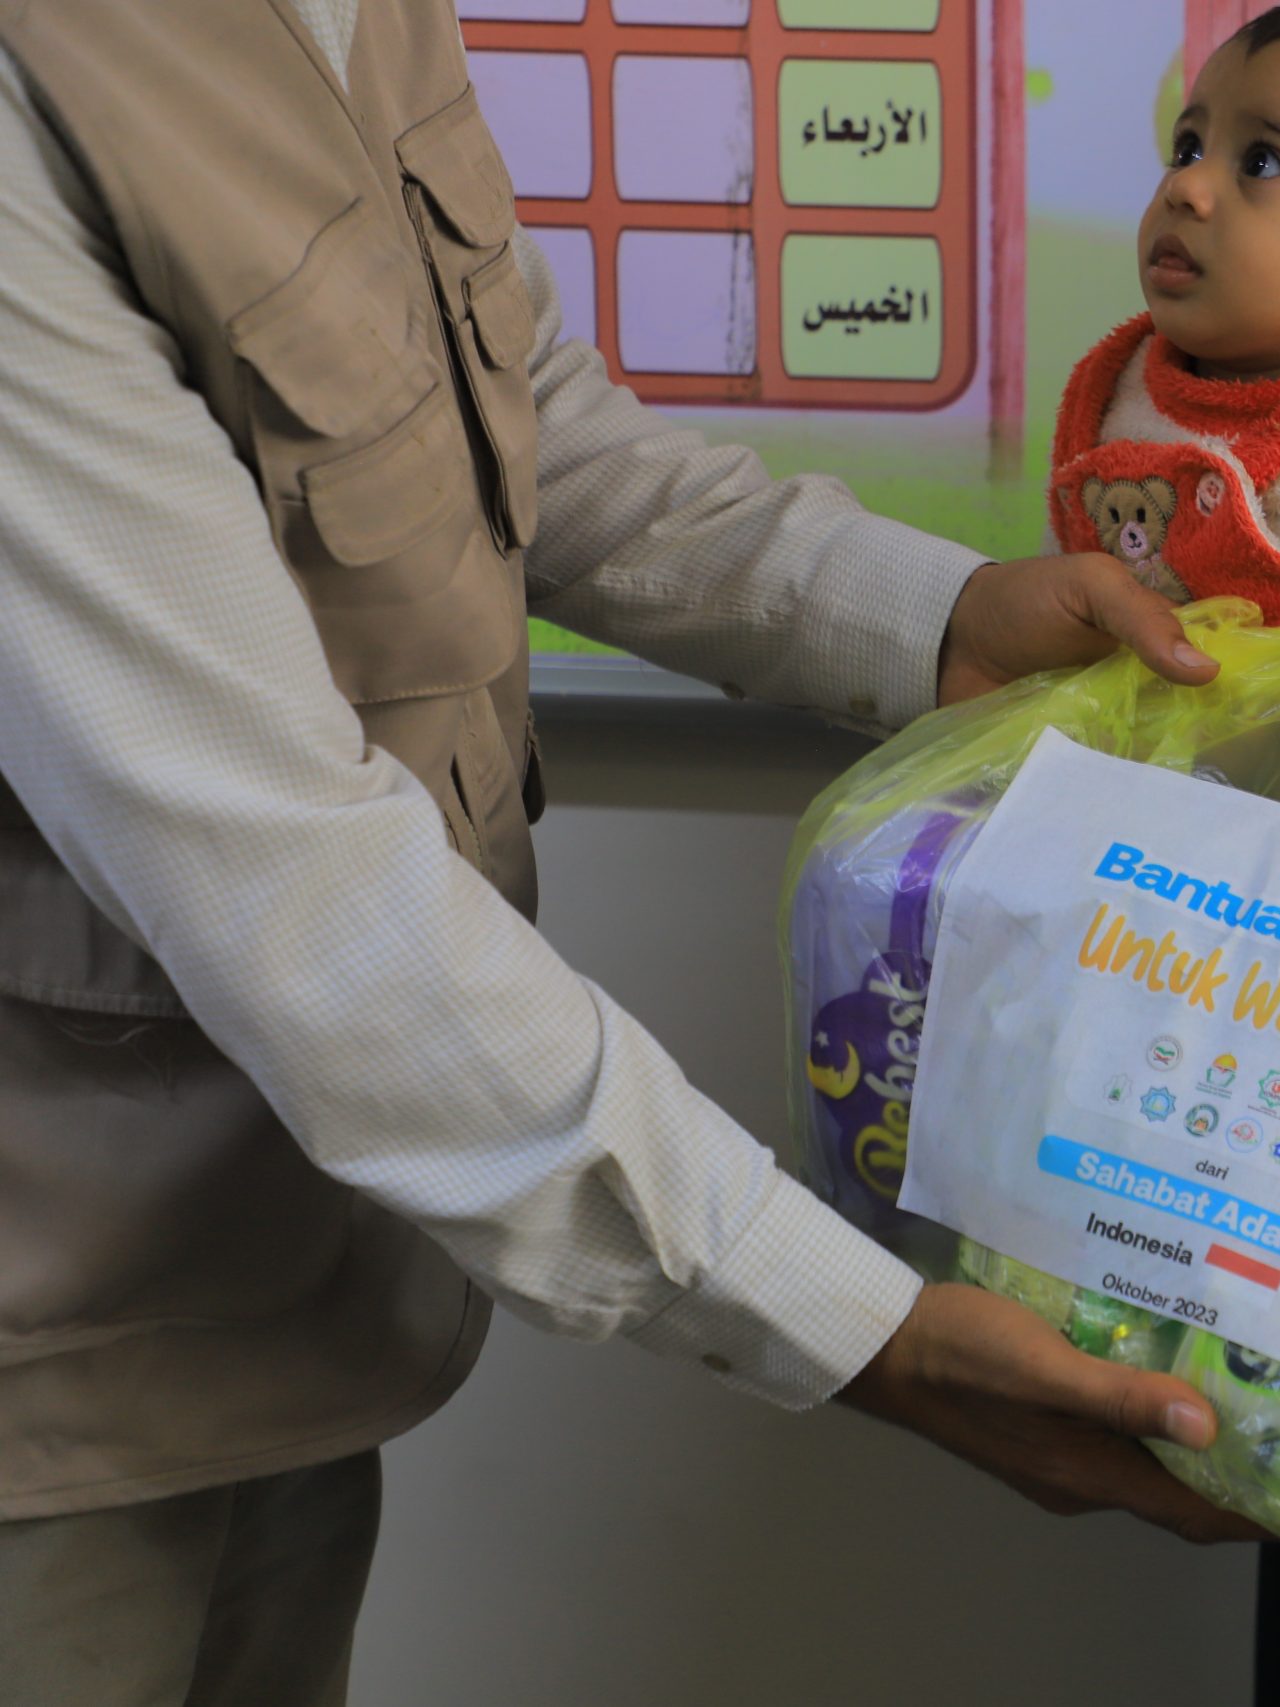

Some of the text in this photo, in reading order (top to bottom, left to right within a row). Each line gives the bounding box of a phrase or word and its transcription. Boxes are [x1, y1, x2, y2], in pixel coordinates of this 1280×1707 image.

[802, 99, 927, 157] الأربعاء
[802, 285, 929, 335] الخميس
[1078, 903, 1228, 1012] Untuk
[1076, 1151, 1211, 1219] Sahabat
[1195, 1160, 1230, 1180] dari
[1086, 1212, 1193, 1267] Indonesia
[1102, 1273, 1218, 1326] Oktober 2023
